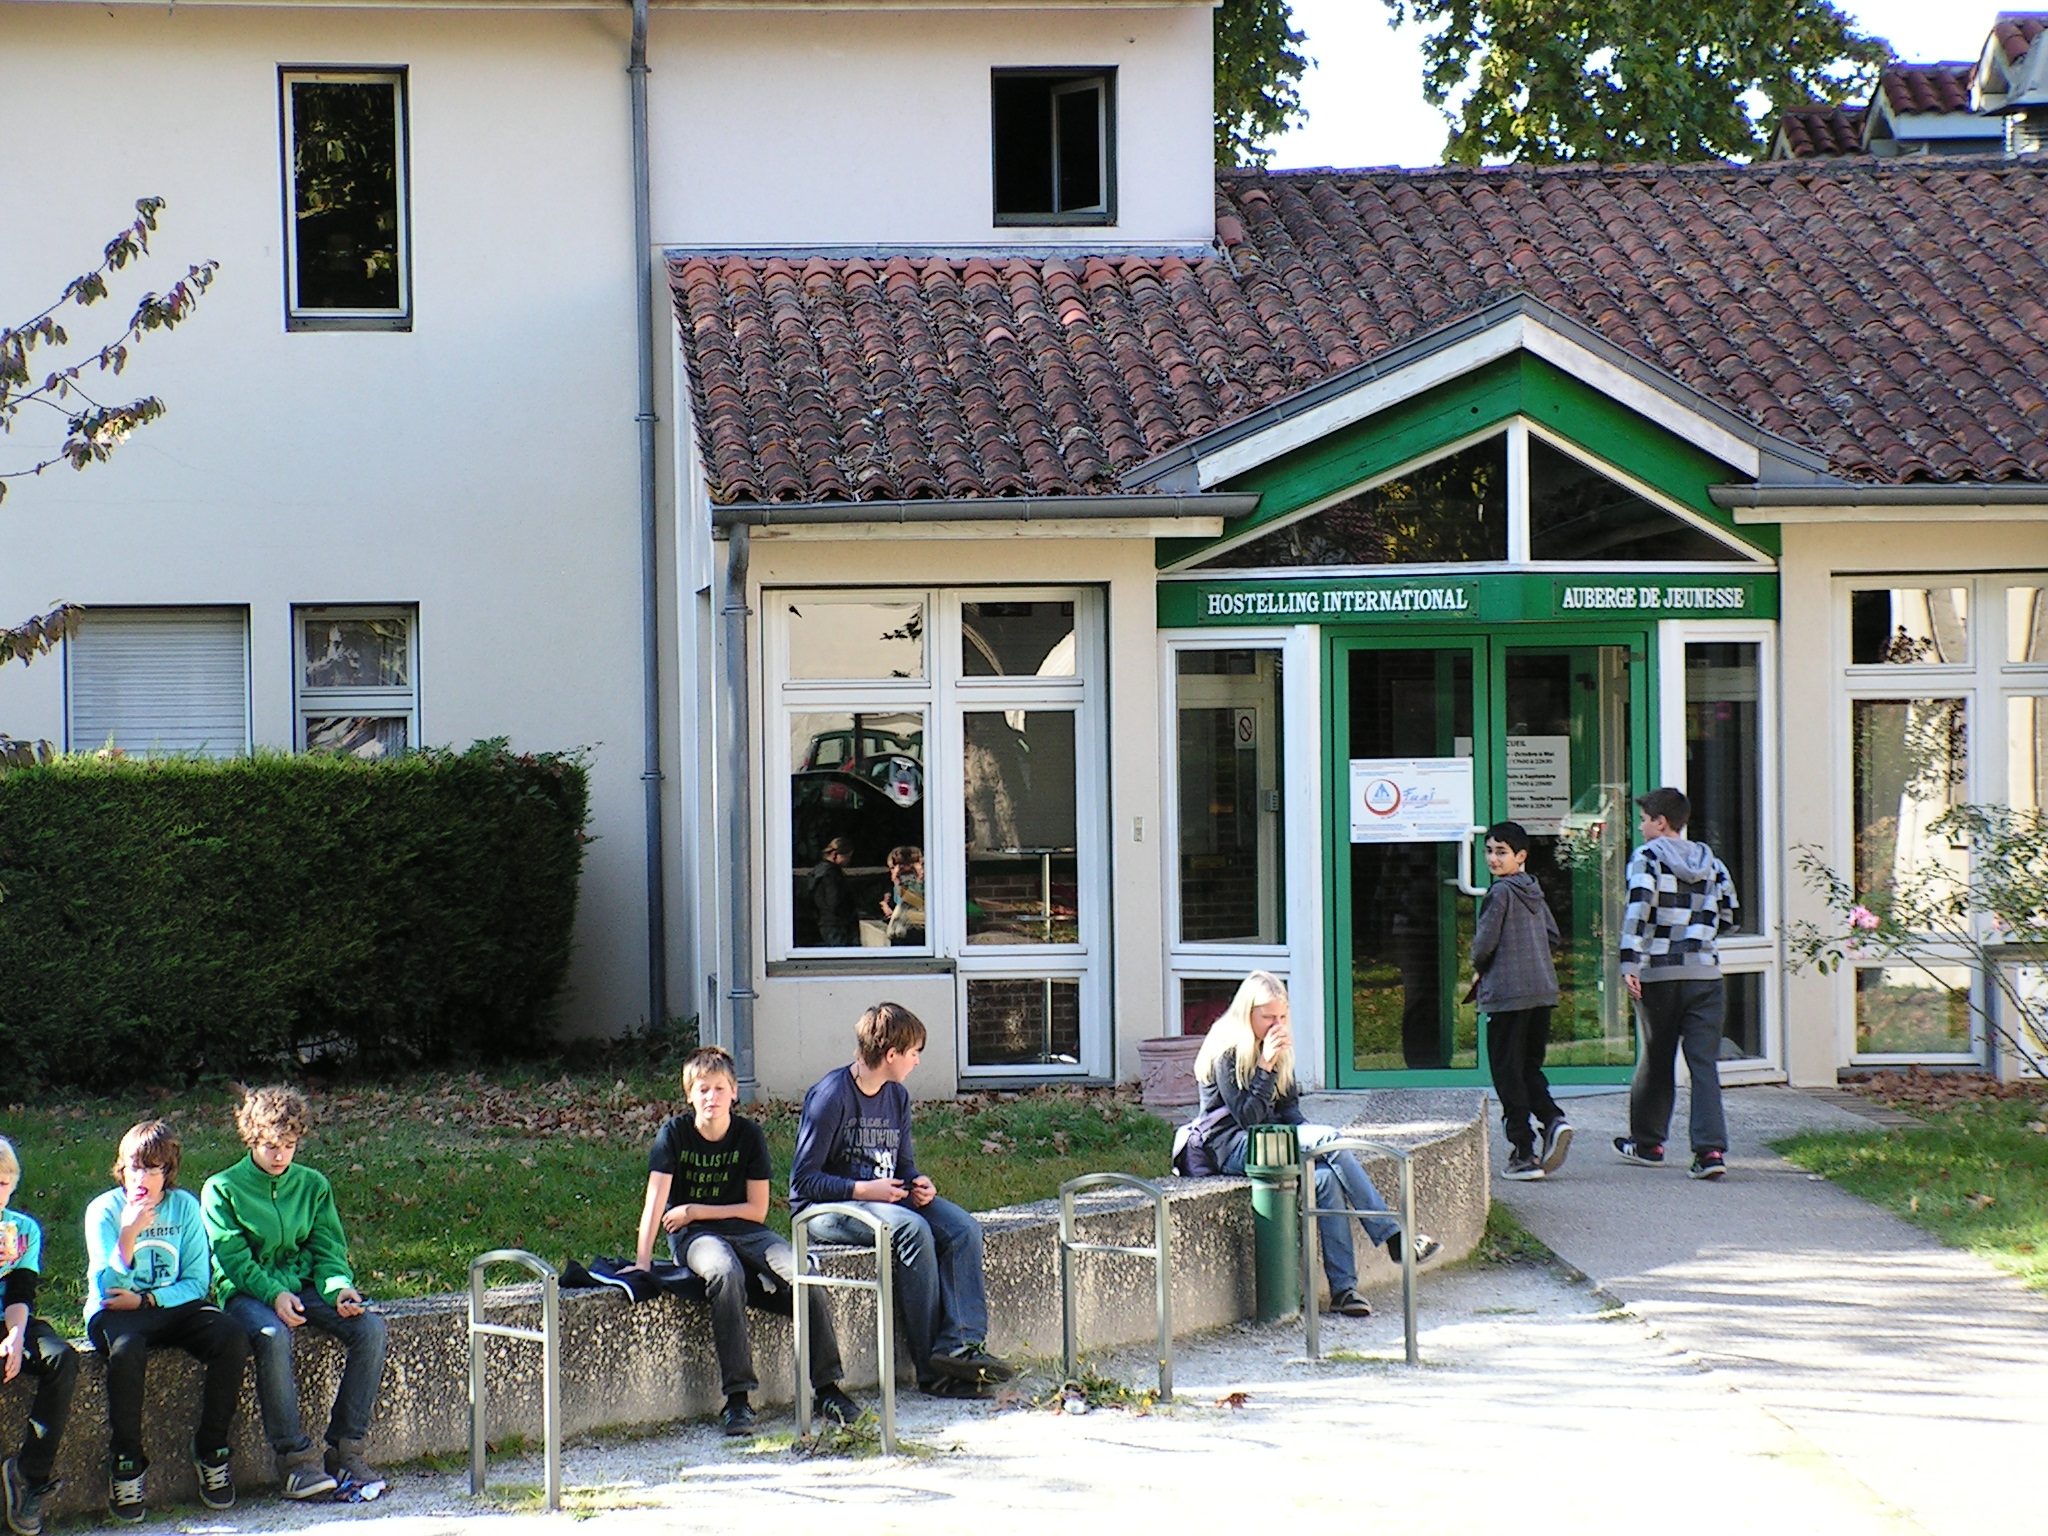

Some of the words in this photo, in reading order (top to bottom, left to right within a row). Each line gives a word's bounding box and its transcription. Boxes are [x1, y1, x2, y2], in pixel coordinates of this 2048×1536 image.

[1208, 592, 1320, 615] HOSTELLING
[1322, 588, 1469, 613] INTERNATIONAL
[1562, 587, 1637, 609] AUBERGE
[1639, 587, 1661, 609] DE
[1663, 587, 1745, 609] JEUNESSE
[685, 1170, 729, 1184] HERMOA
[690, 1186, 720, 1199] BEH
